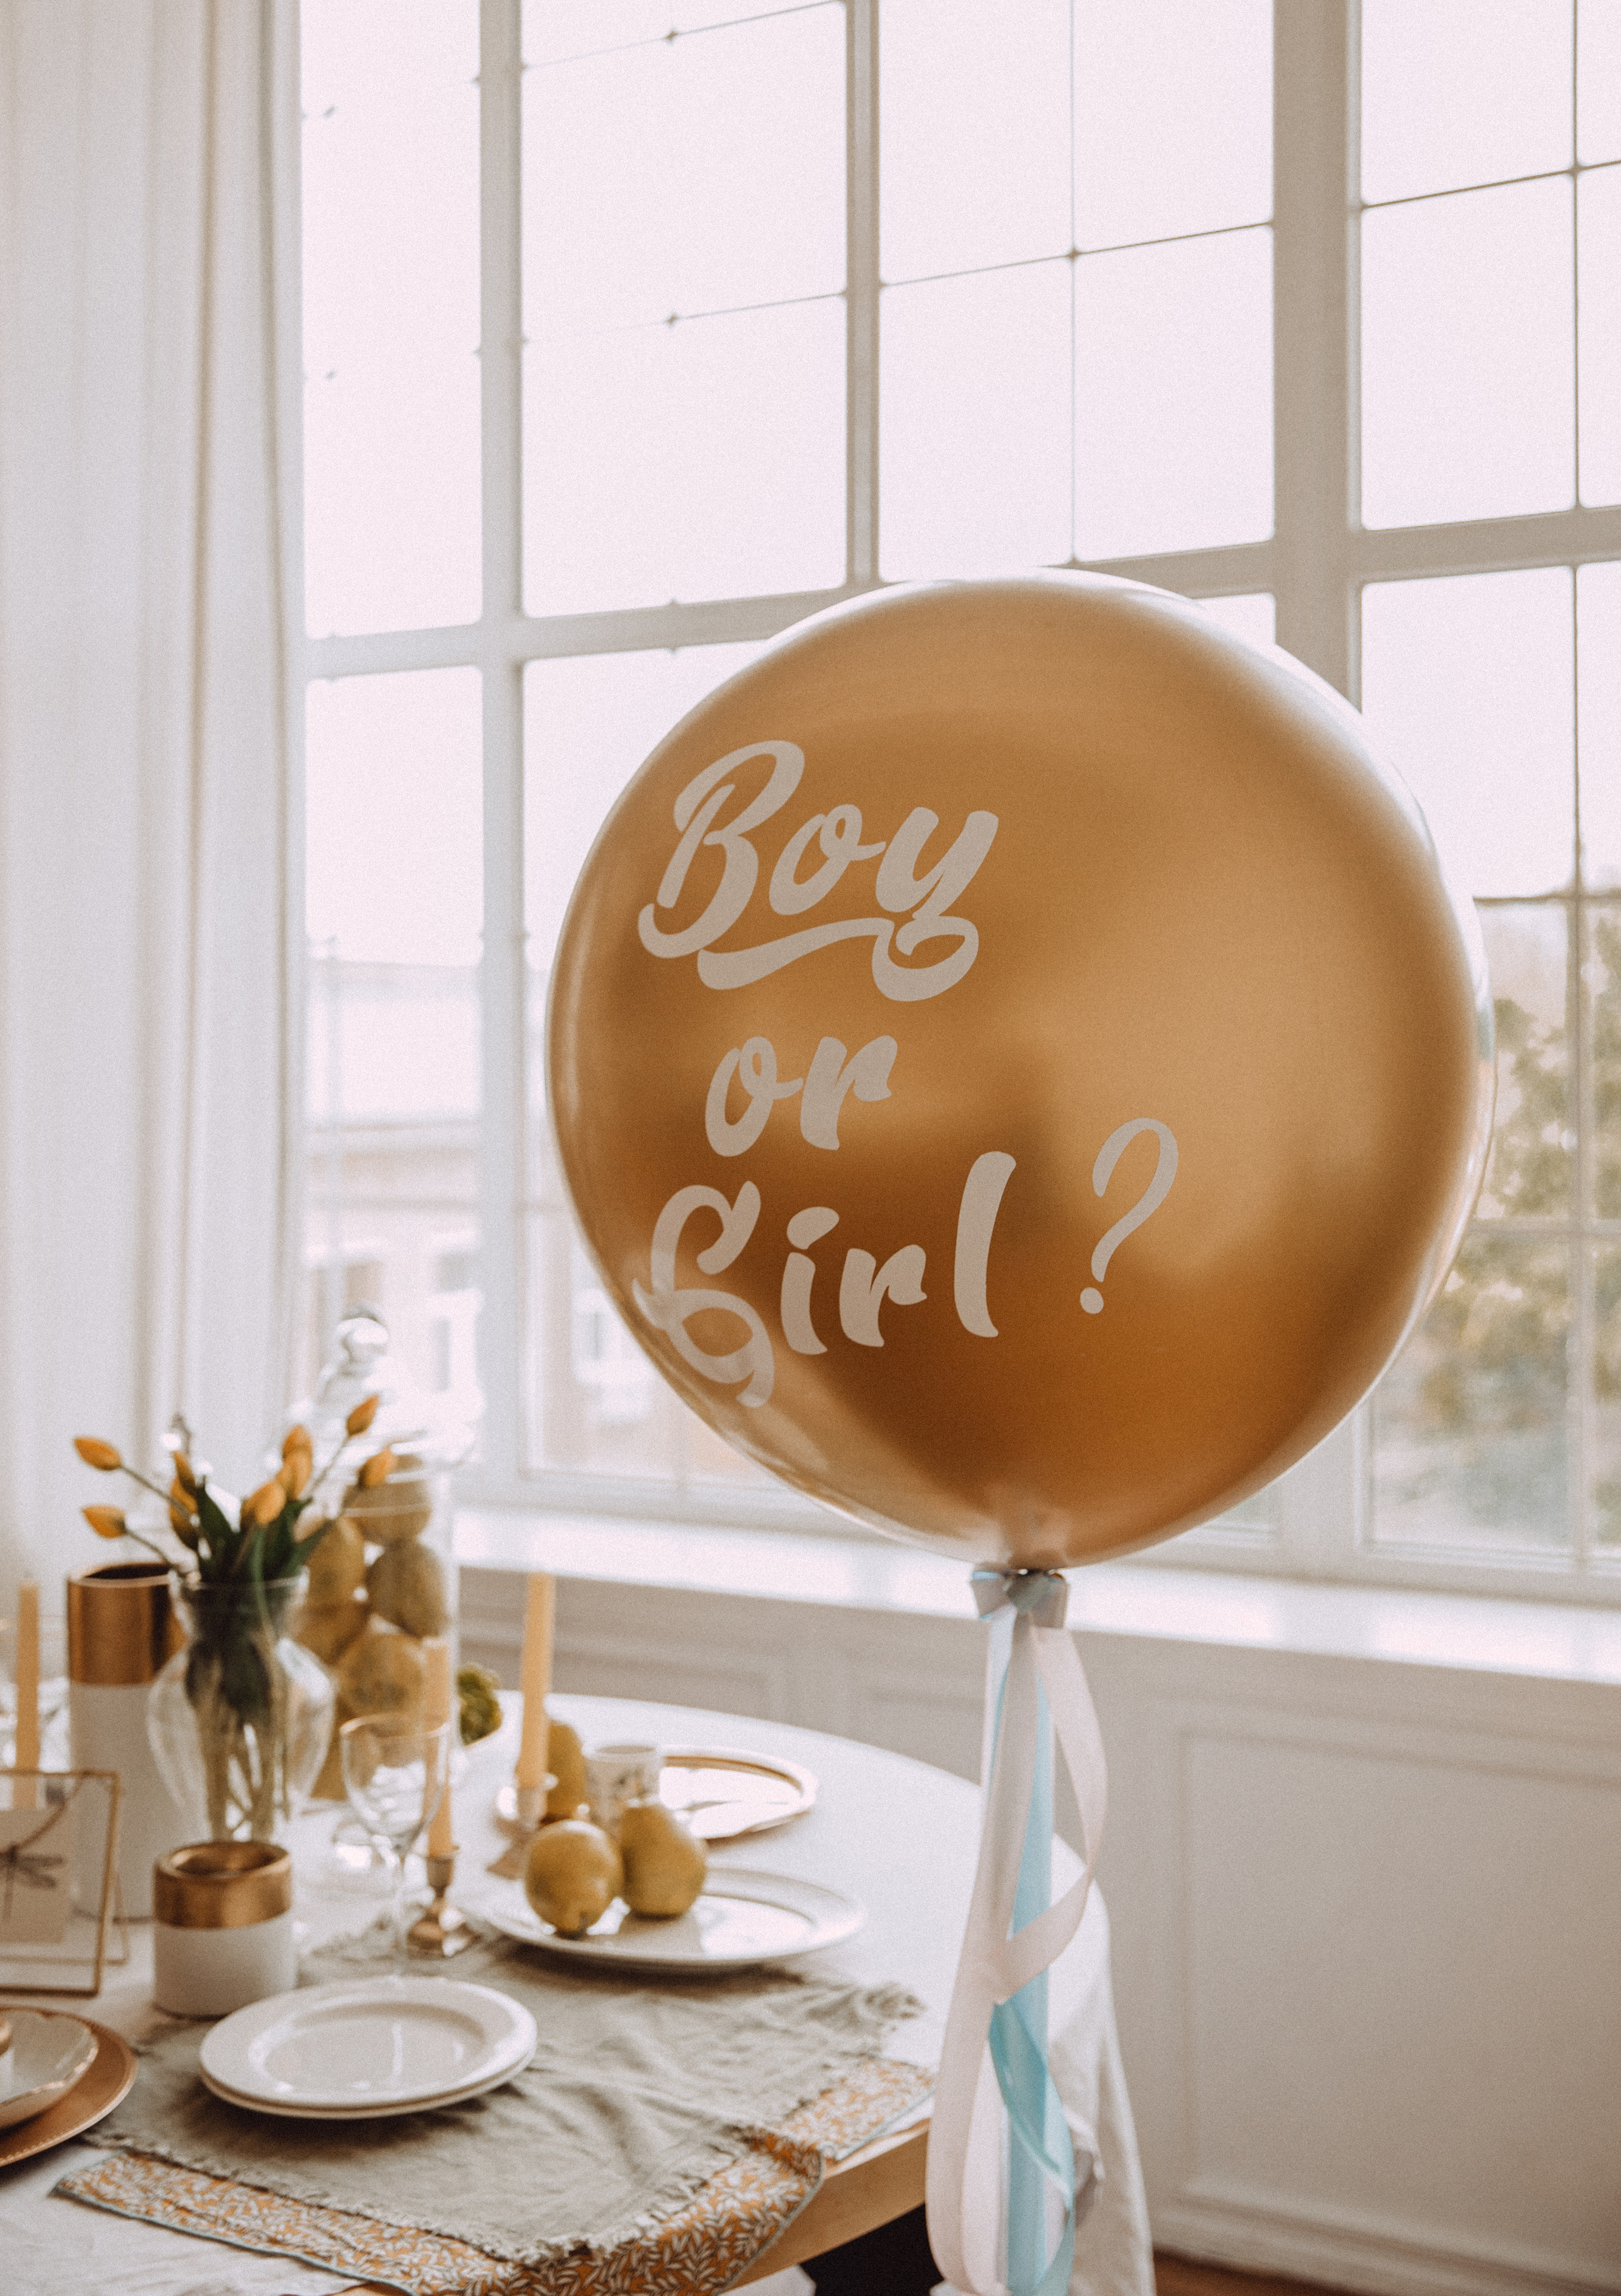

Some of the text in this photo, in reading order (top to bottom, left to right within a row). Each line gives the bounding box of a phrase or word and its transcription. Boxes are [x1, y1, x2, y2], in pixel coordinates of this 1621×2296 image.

[638, 739, 999, 1001] Boy
[705, 1035, 898, 1157] or
[632, 1151, 1017, 1408] Girl
